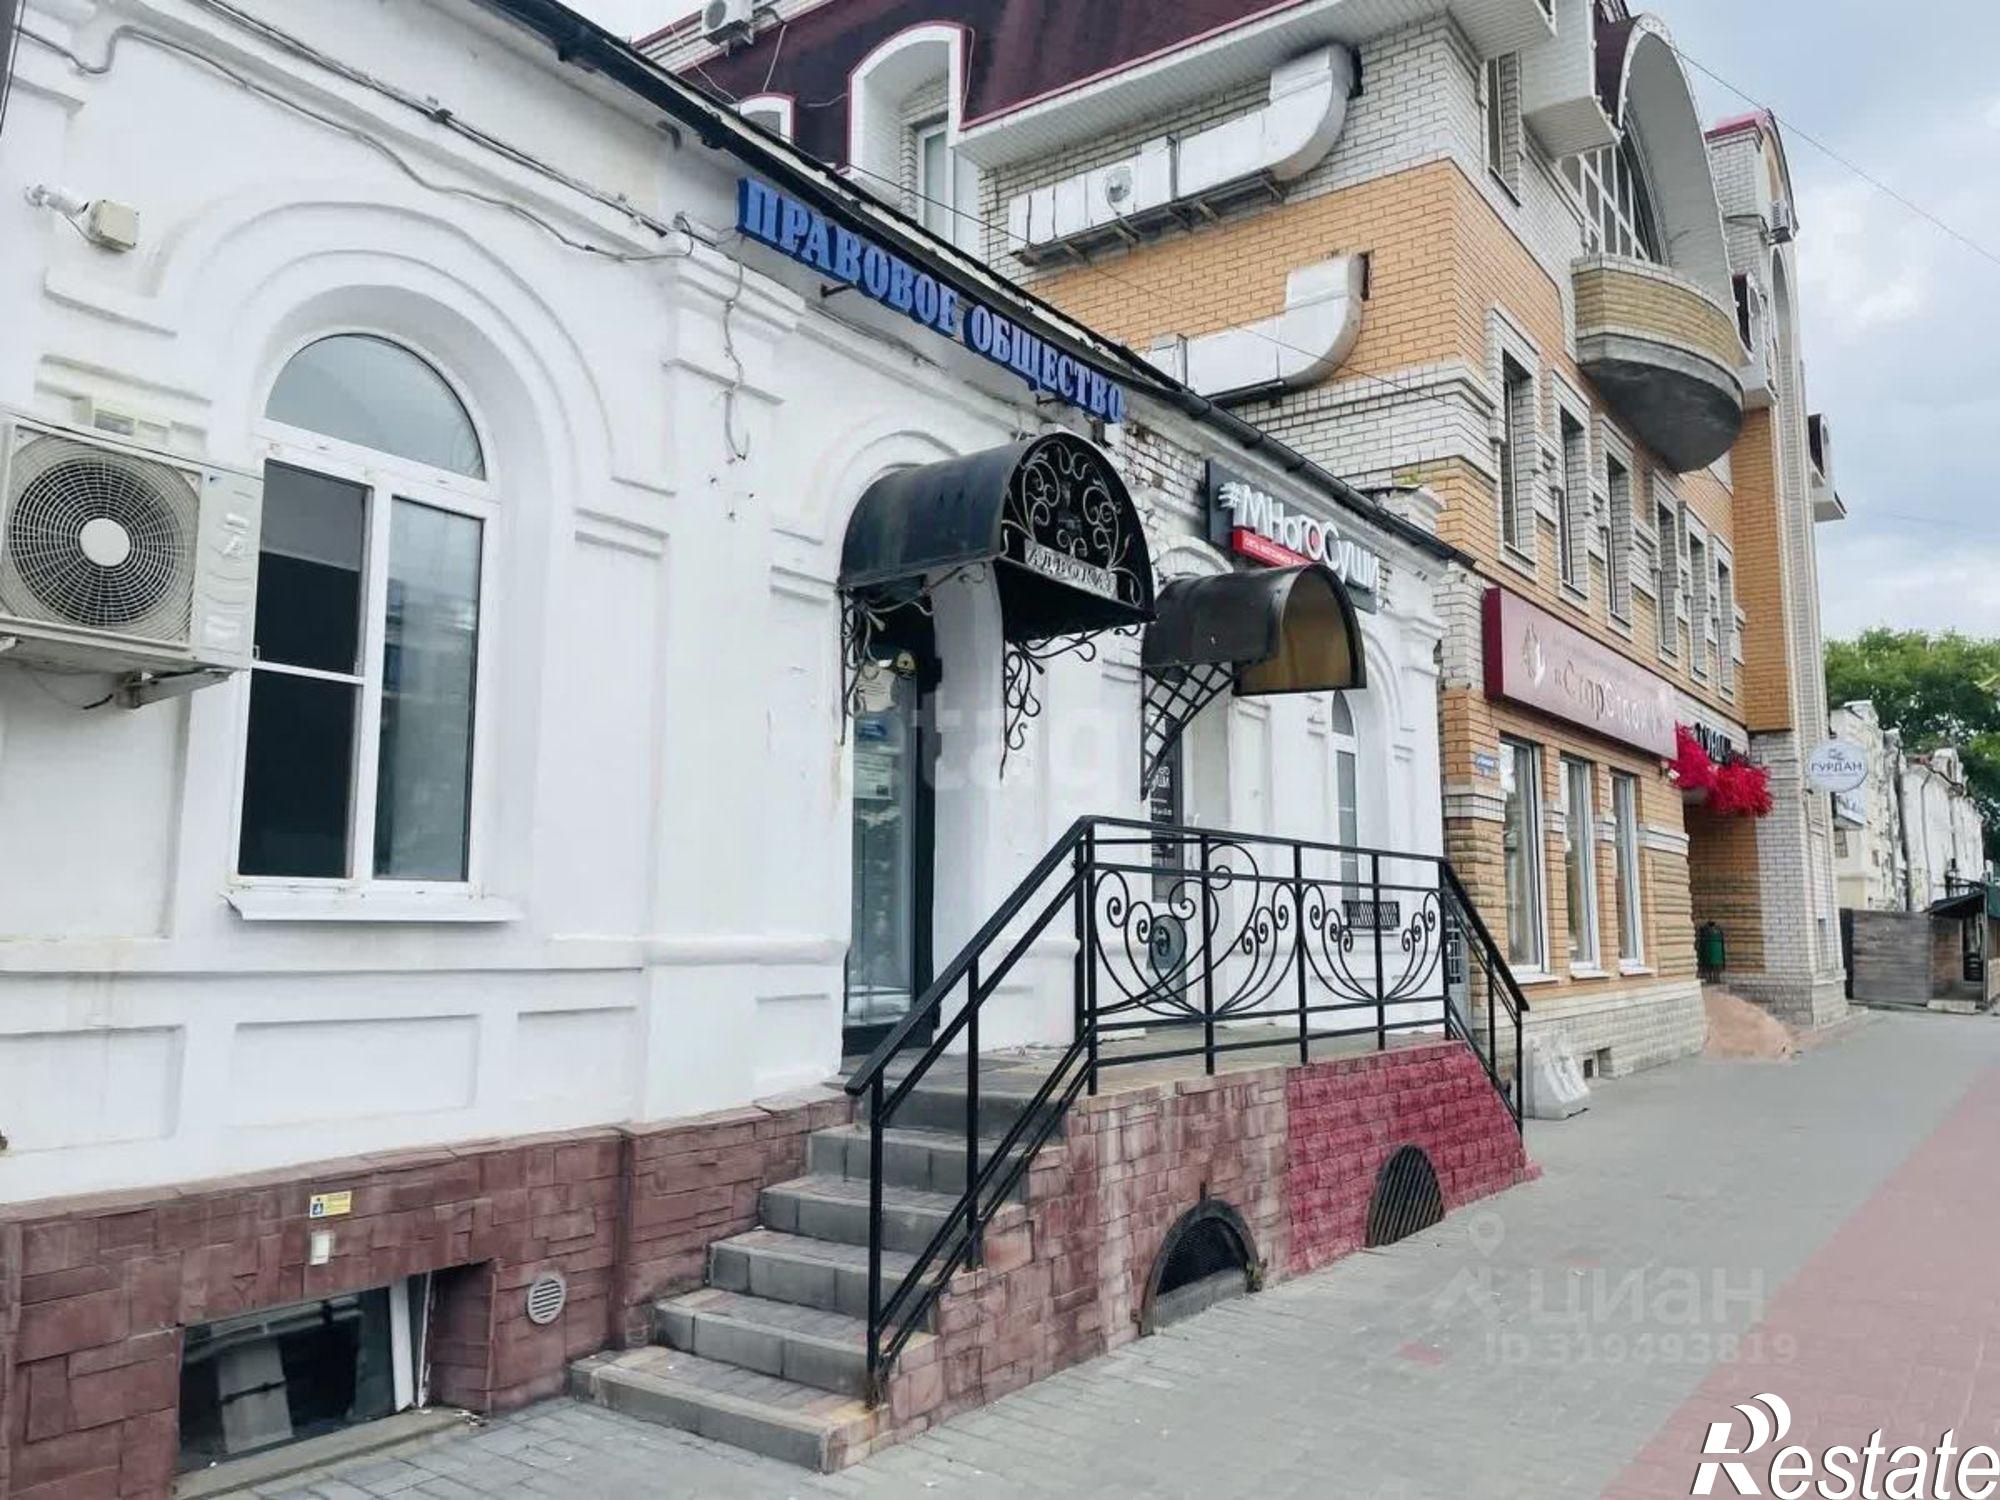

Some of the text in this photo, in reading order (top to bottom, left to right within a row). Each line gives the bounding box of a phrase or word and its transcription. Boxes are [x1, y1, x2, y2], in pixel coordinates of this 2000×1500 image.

[738, 177, 1125, 423] ПРАВОВОЕ ОБЩЕСТВО
[1811, 761, 1862, 773] ГУРДАН
